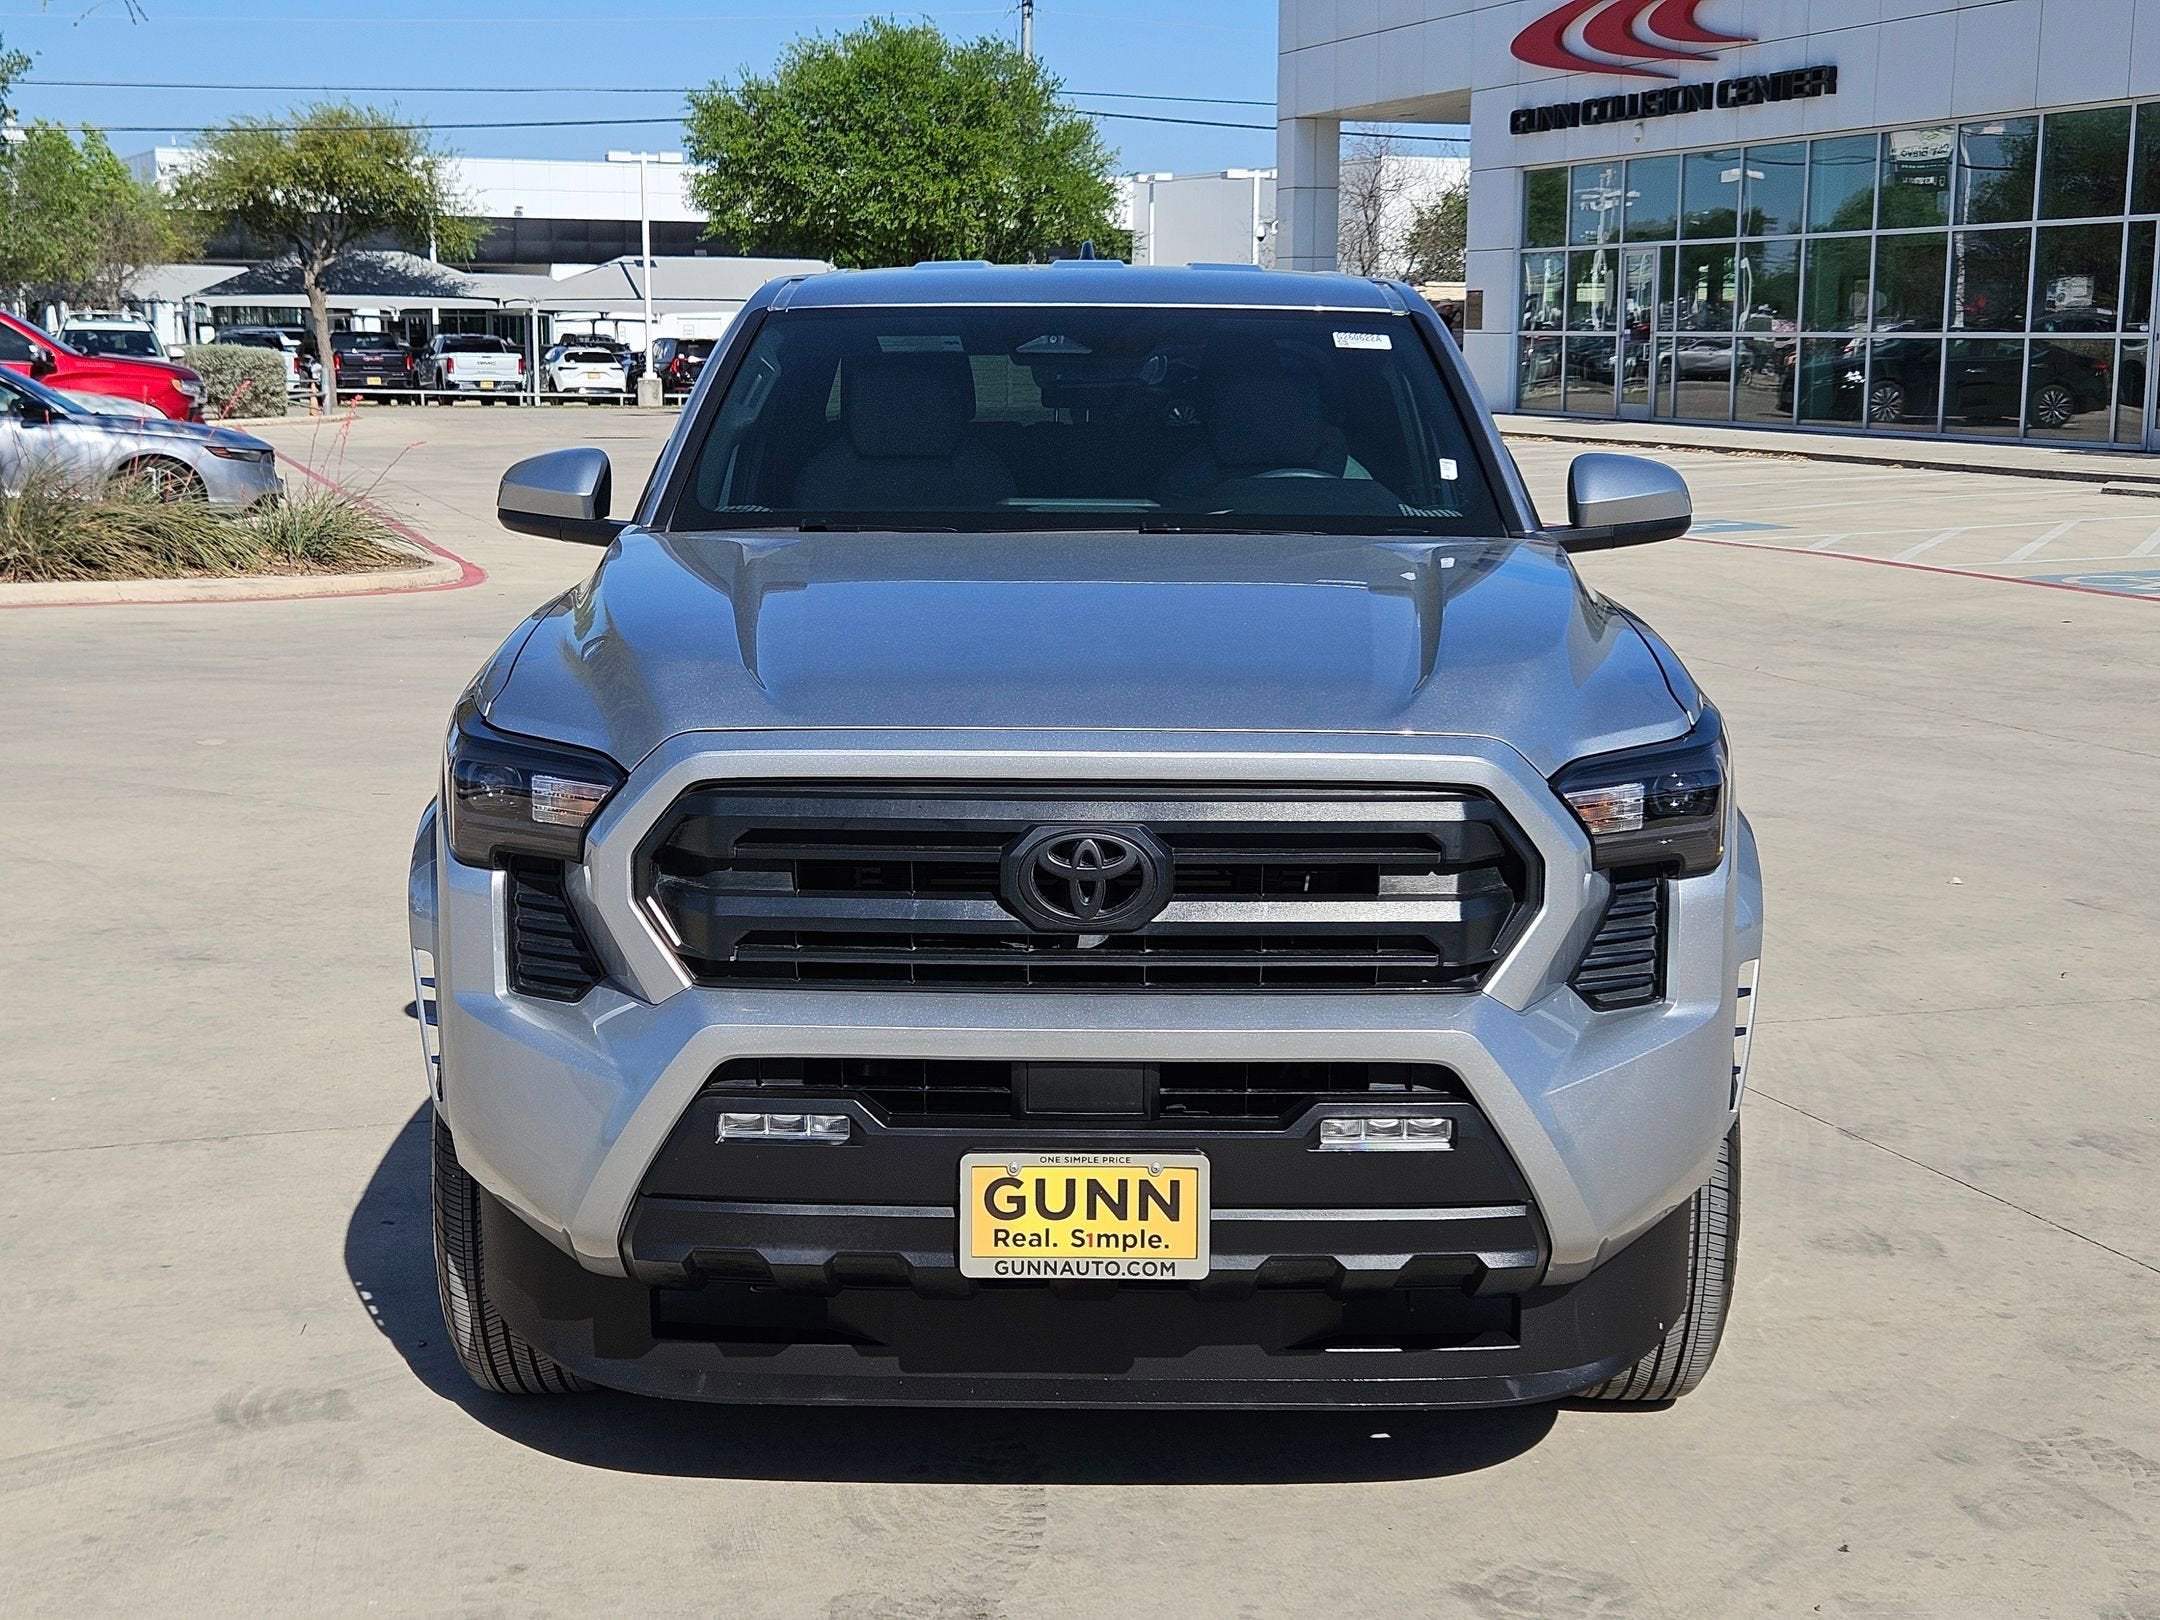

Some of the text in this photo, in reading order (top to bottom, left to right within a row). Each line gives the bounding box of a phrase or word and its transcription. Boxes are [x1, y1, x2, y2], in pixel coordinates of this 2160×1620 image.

[1510, 65, 1838, 135] GUNN COLLISION CENTER
[1039, 1156, 1131, 1164] ONE SIMPLE PRICE
[984, 1177, 1180, 1222] GUNN
[993, 1228, 1170, 1252] Real. S1mple.
[994, 1260, 1176, 1277] GUNNAUTO.COM
